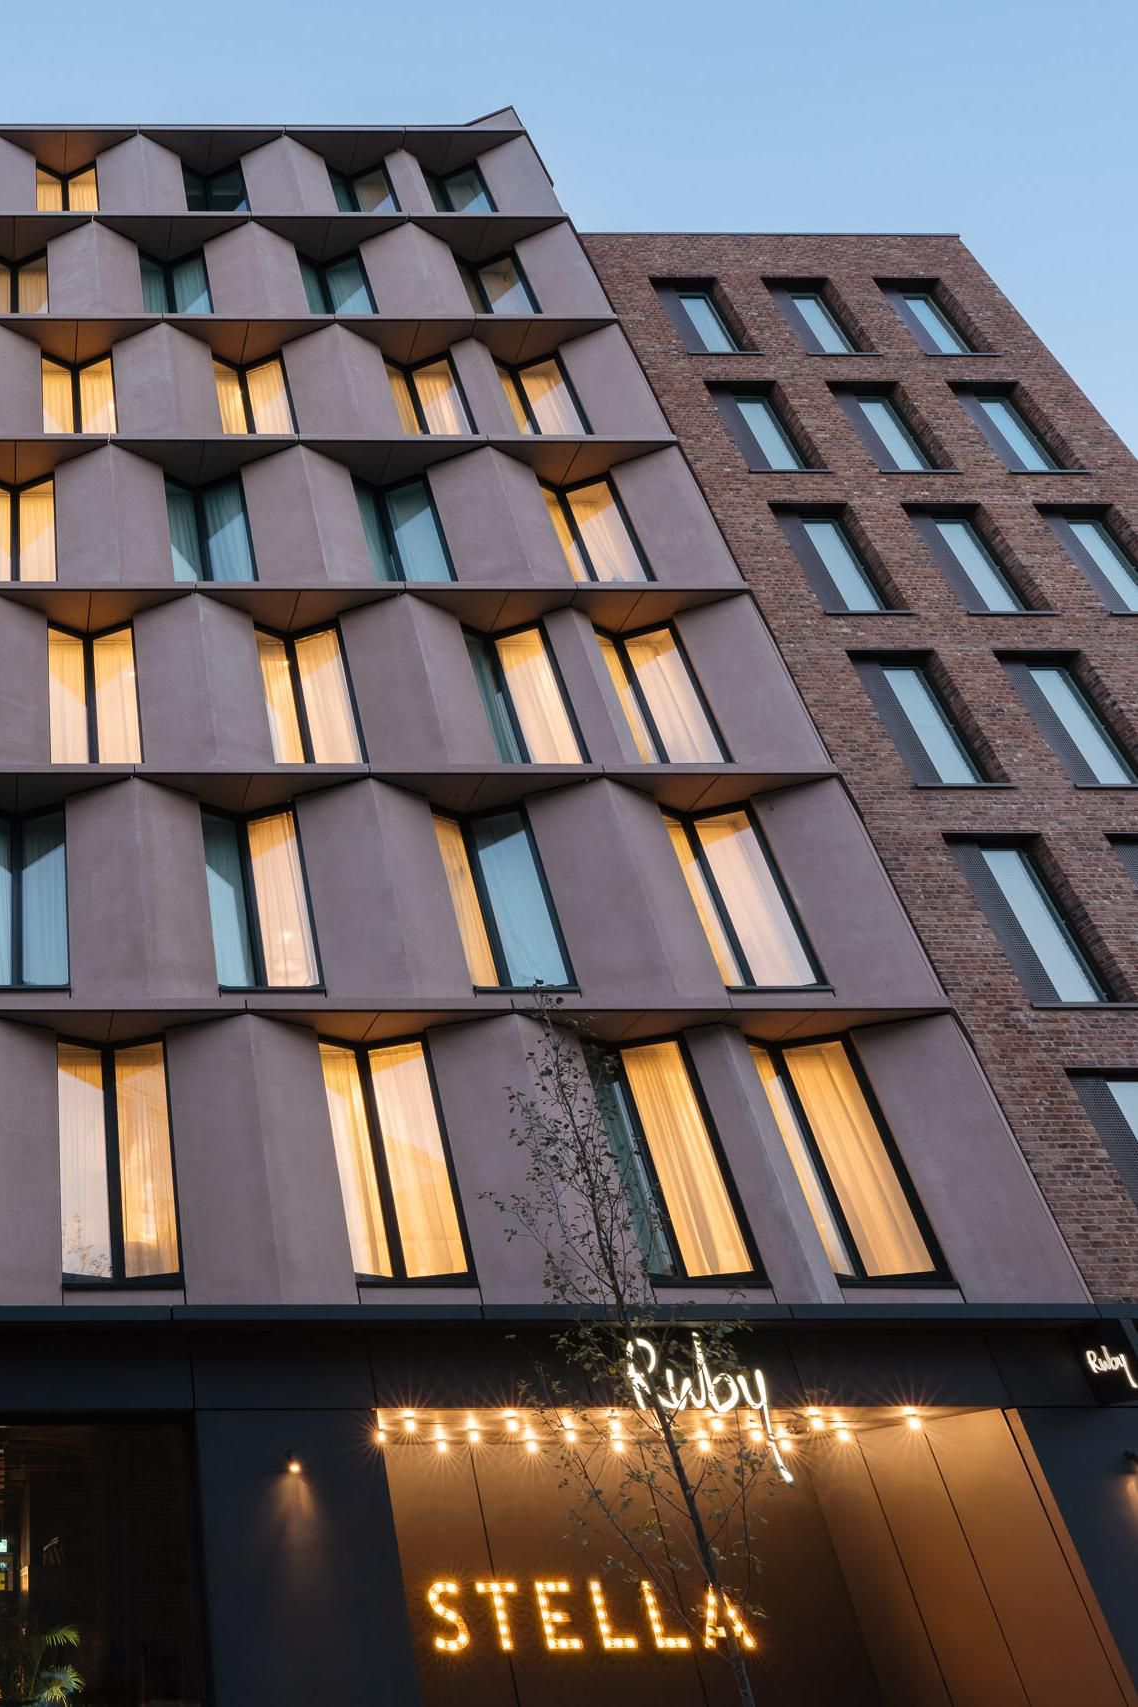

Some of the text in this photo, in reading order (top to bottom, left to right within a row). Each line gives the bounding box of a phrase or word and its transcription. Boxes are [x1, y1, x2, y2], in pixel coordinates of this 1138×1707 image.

[1086, 1345, 1138, 1388] Ruby
[625, 1331, 794, 1483] Ruby
[428, 1581, 757, 1651] STELLA
